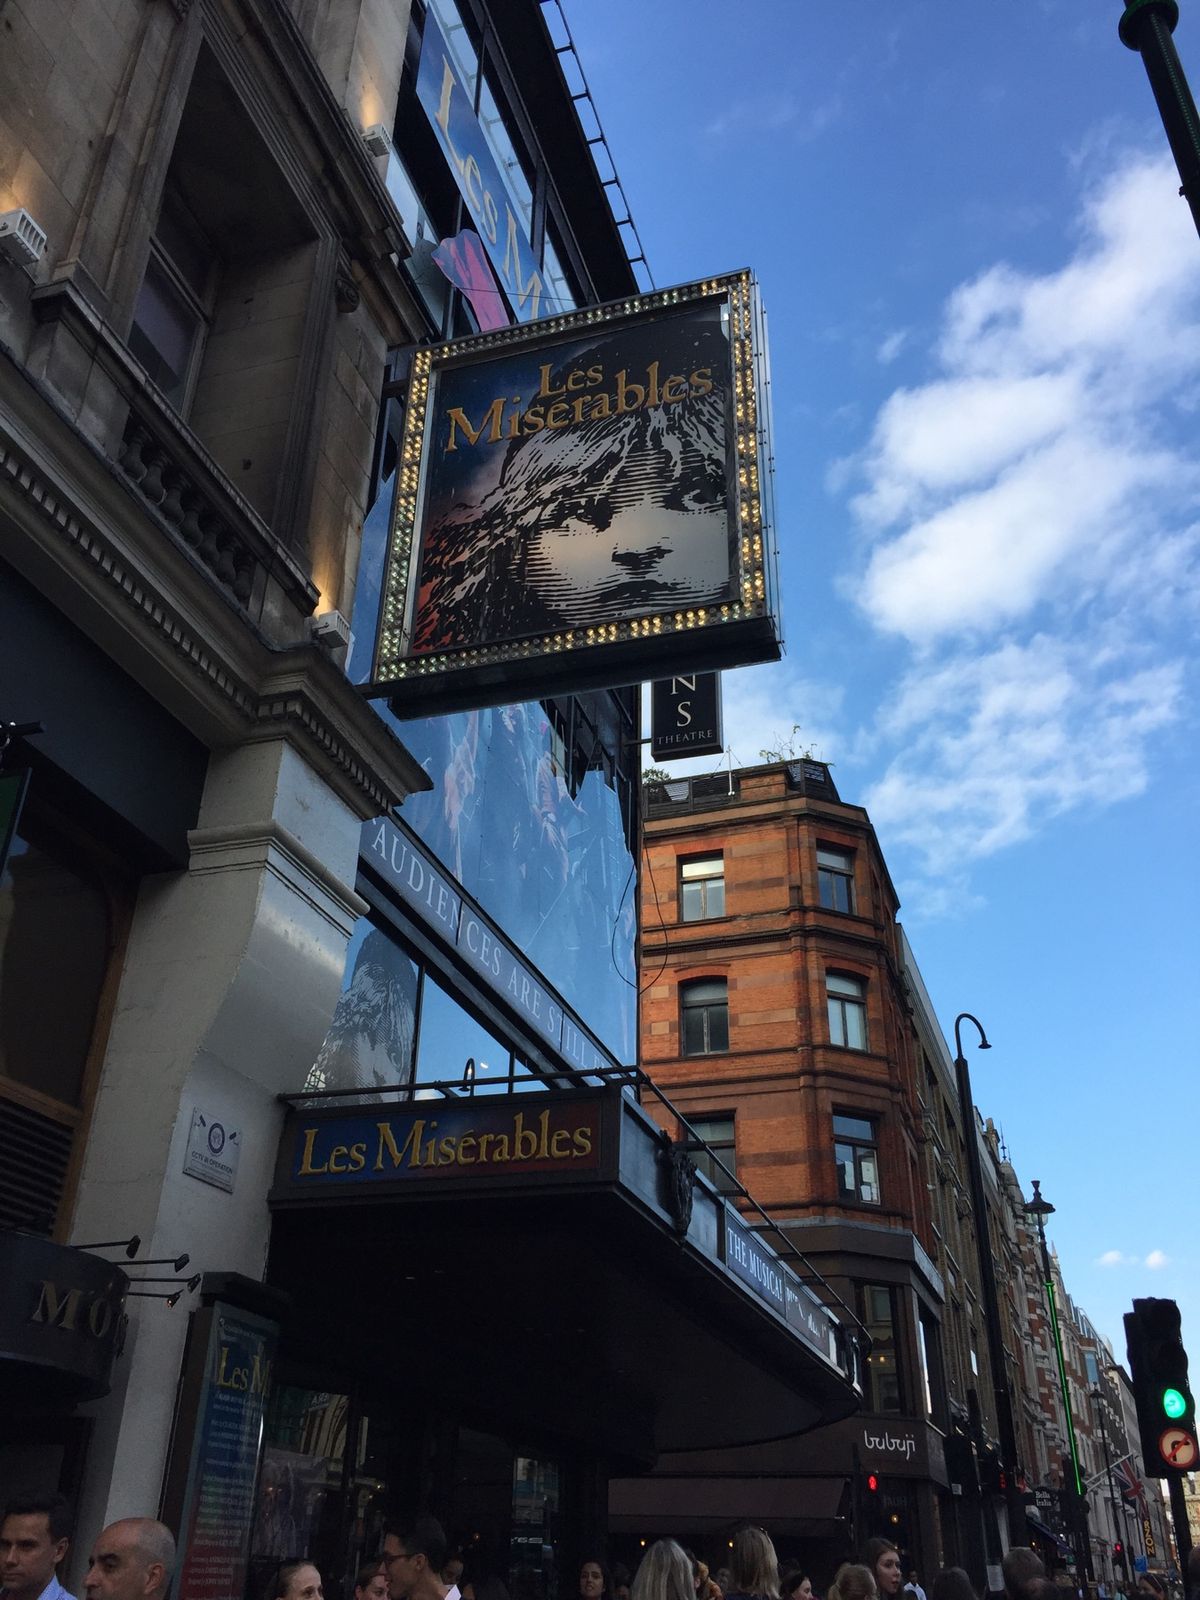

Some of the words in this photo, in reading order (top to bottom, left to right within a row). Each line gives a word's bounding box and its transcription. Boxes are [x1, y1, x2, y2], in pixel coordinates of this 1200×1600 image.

[444, 360, 714, 453] Misérables
[538, 362, 604, 400] Les
[657, 729, 713, 745] THEATRE
[507, 967, 542, 1020] ARE
[547, 1006, 587, 1069] STILL
[298, 1127, 367, 1176] Les
[374, 1109, 592, 1171] Misérables
[728, 1228, 747, 1268] THE
[749, 1249, 783, 1302] MUSICAL
[216, 1346, 249, 1392] Les
